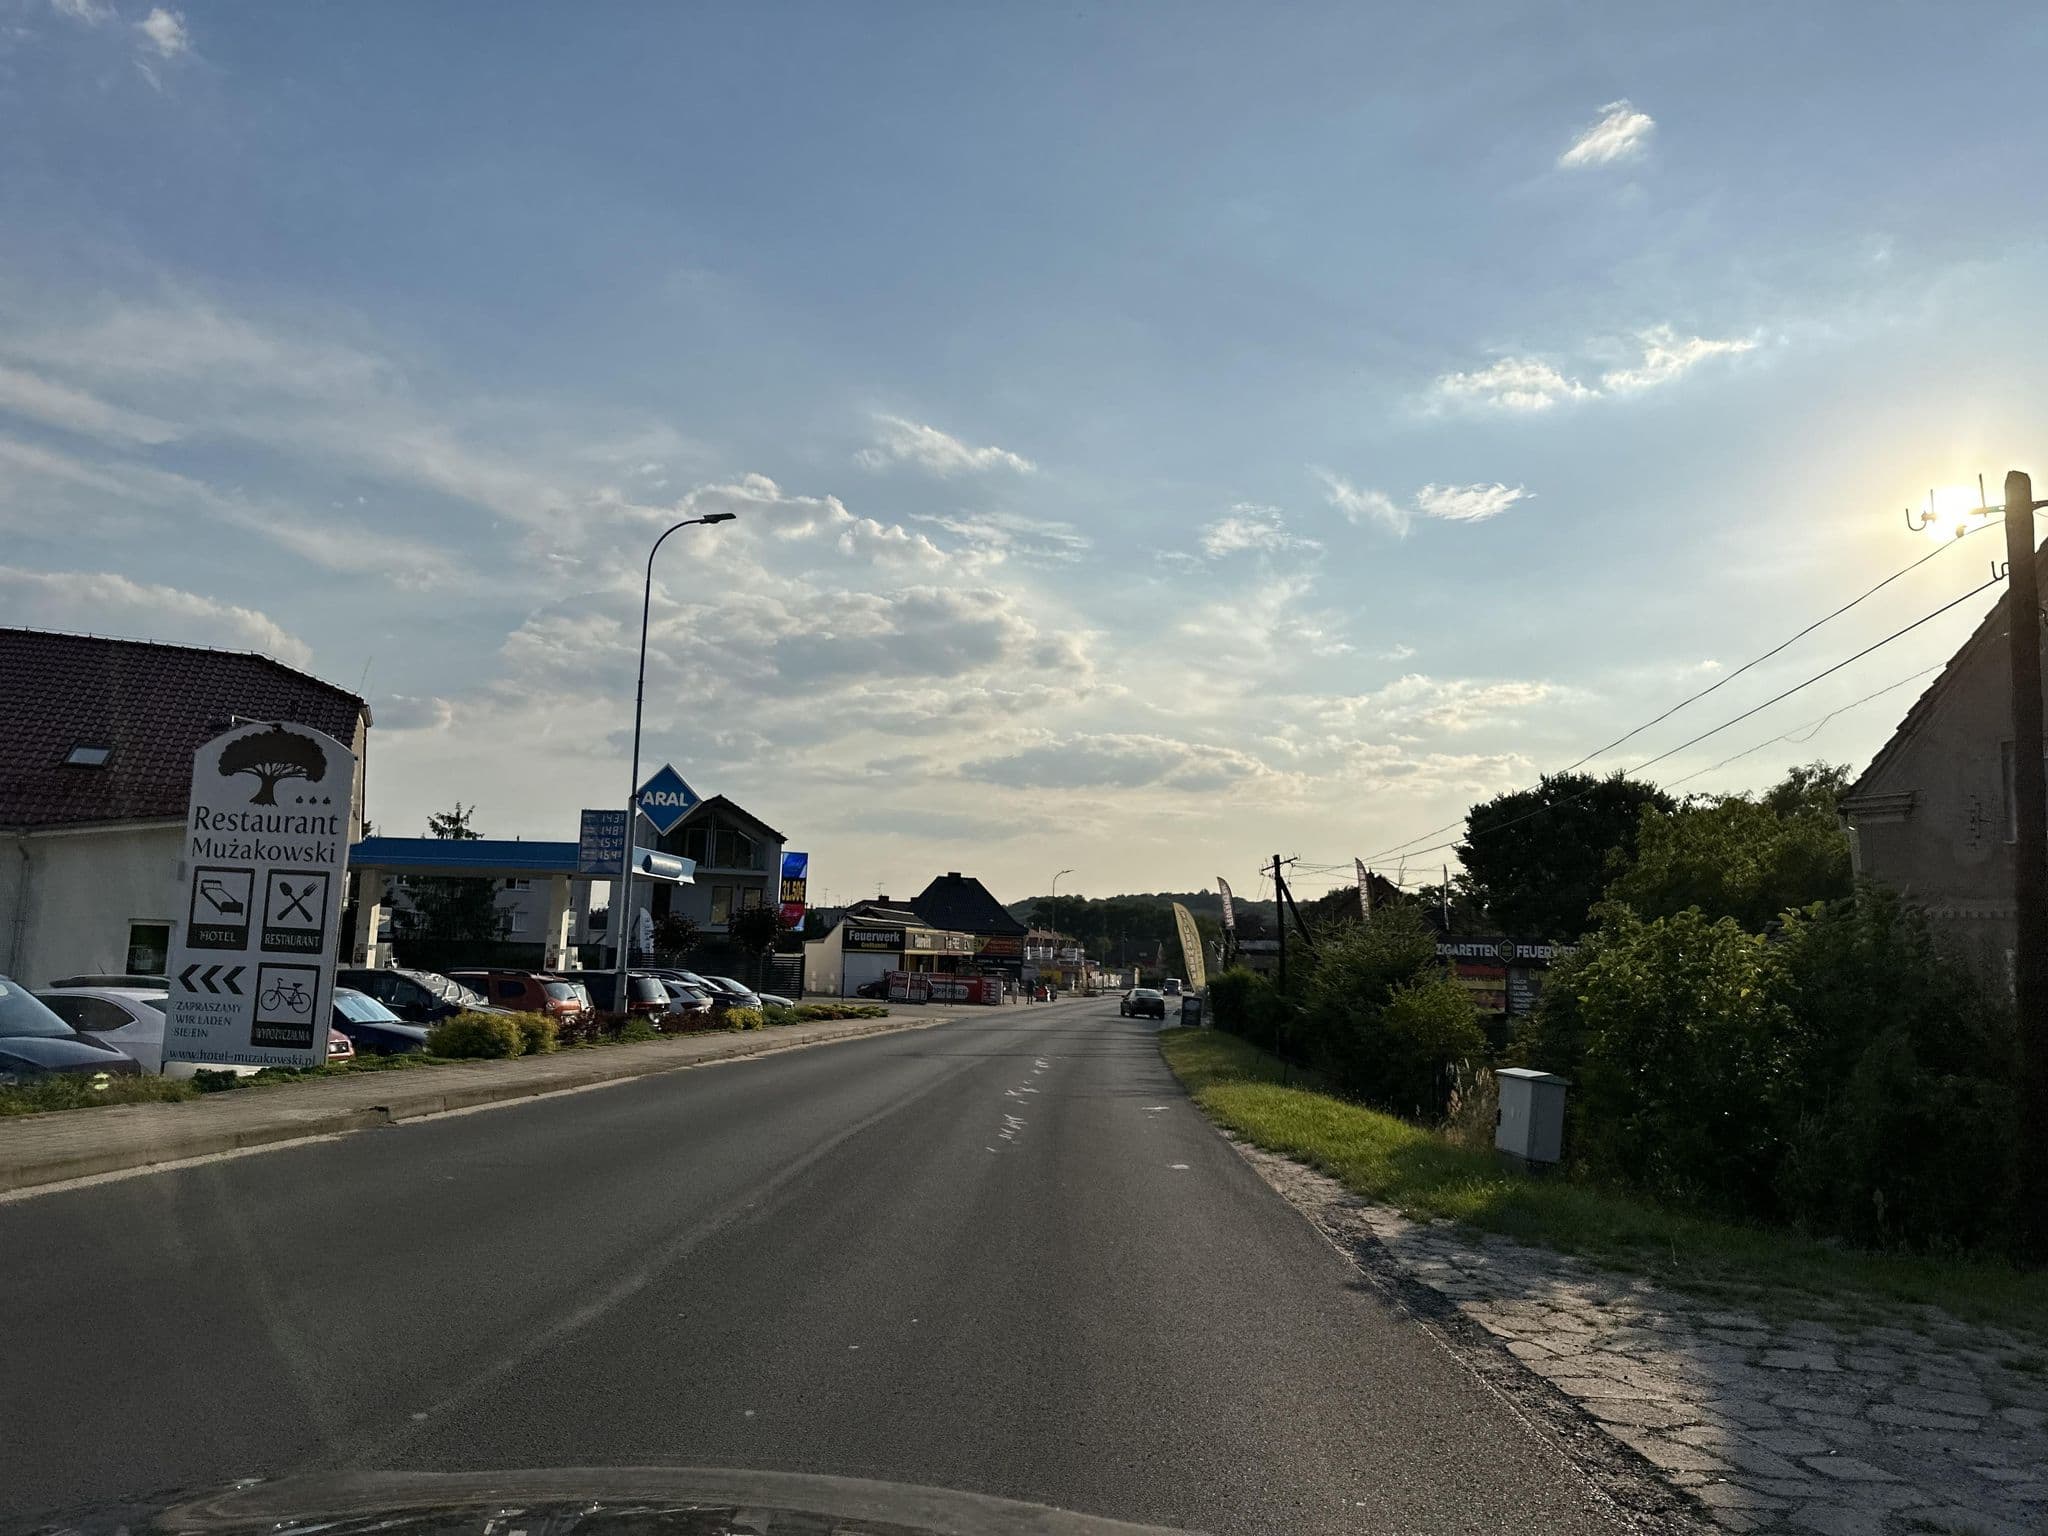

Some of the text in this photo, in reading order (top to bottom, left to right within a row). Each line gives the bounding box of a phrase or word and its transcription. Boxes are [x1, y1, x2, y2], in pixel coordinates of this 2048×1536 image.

[641, 790, 689, 807] ARAL
[194, 806, 339, 835] Restaurant
[192, 837, 336, 863] Mużakowski
[199, 930, 236, 942] HOTEL
[264, 933, 320, 947] RESTAURANT
[848, 930, 900, 943] Feuerwerk
[1436, 943, 1499, 957] ZIGARETTEN
[175, 1001, 241, 1013] ZAPRASZAMY
[175, 1014, 232, 1026] WIR LADEN
[174, 1027, 208, 1038] SIE EIN
